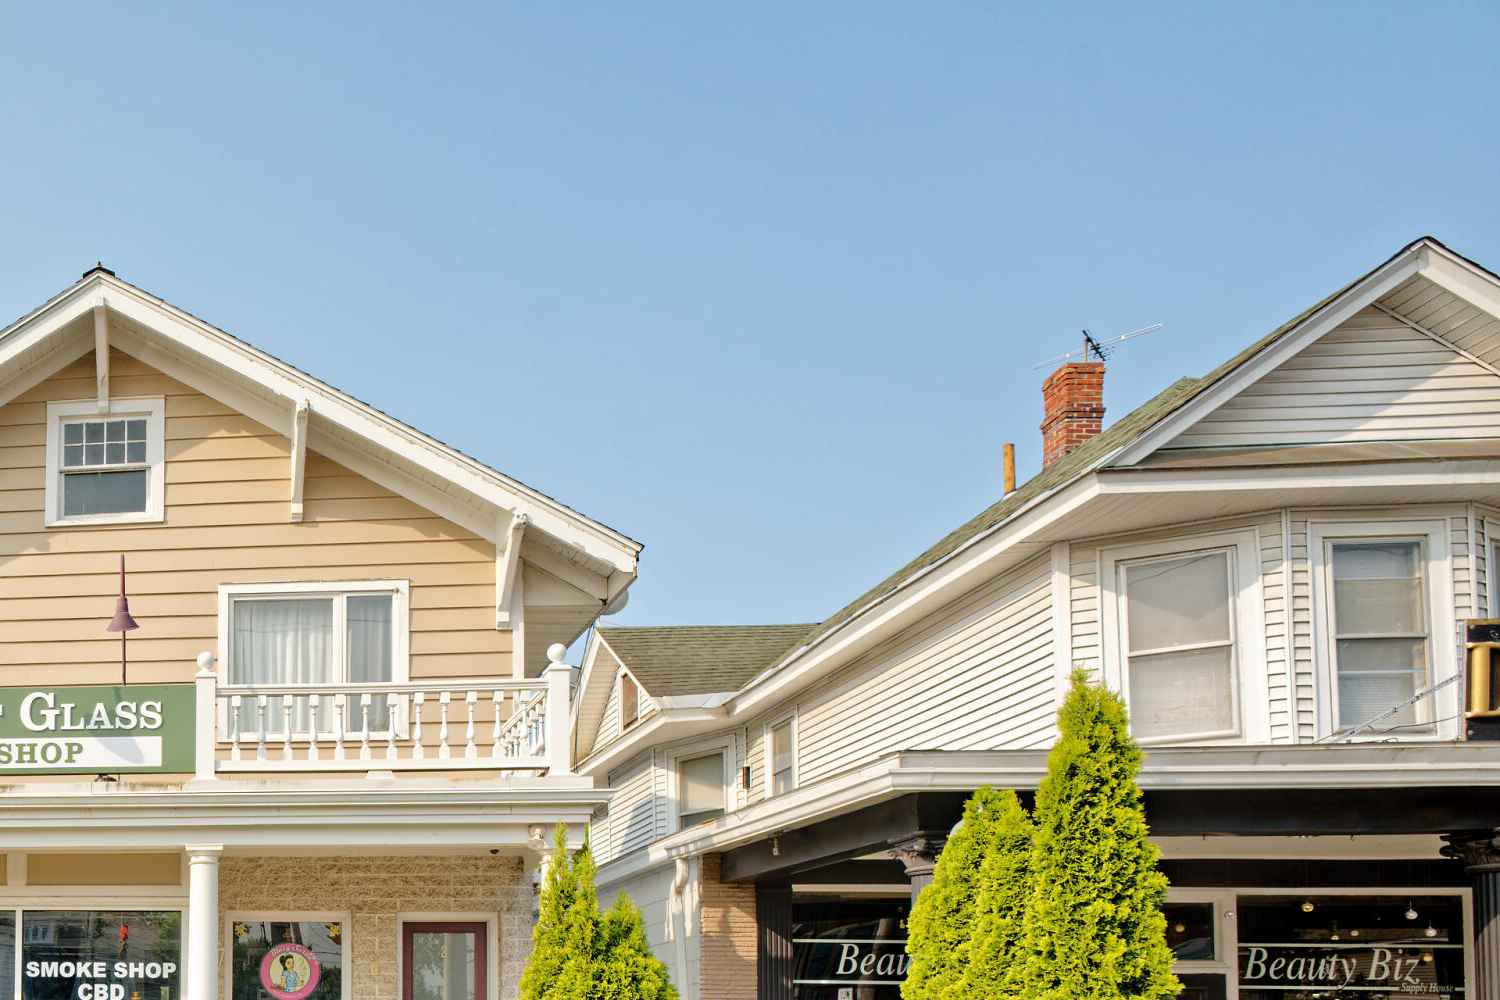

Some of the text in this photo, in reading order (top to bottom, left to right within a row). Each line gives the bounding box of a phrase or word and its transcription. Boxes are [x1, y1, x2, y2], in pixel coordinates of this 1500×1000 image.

[19, 691, 164, 732] GLASS
[26, 961, 177, 979] SMOKE SHOP
[836, 943, 914, 975] Beau
[1243, 947, 1421, 990] Beauty Biz
[77, 983, 125, 1000] CBD
[1401, 982, 1454, 995] Supply House
